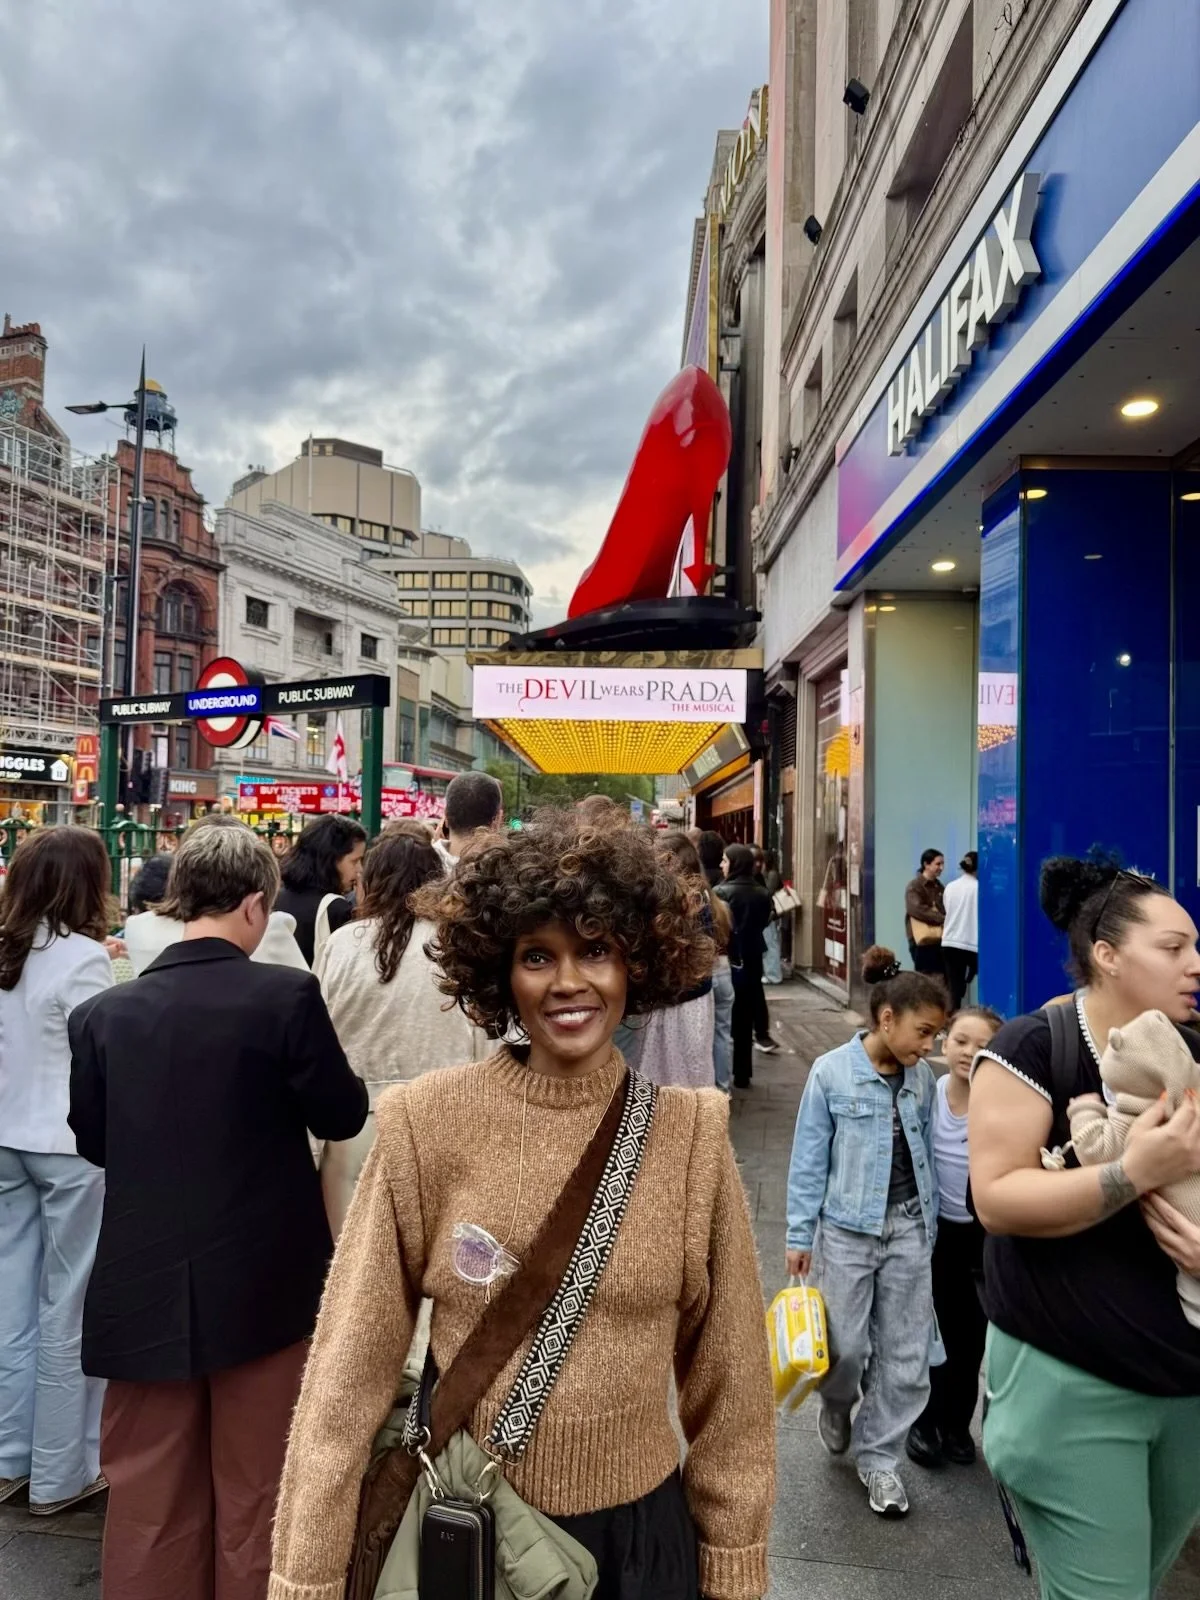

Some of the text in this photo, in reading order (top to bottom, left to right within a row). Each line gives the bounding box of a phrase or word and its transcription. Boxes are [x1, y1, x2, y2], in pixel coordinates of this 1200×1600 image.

[887, 172, 1042, 457] HALIFAX
[278, 685, 355, 704] PUBLIC SUBWAY
[496, 678, 736, 703] THE DEVIL WEARS PRADA
[112, 701, 171, 716] PUBLIC SUBWAY
[188, 693, 257, 710] UNDERGROUND
[671, 703, 736, 713] THE MUSICAL
[169, 779, 197, 794] KING
[259, 785, 319, 796] BUY TICKETS
